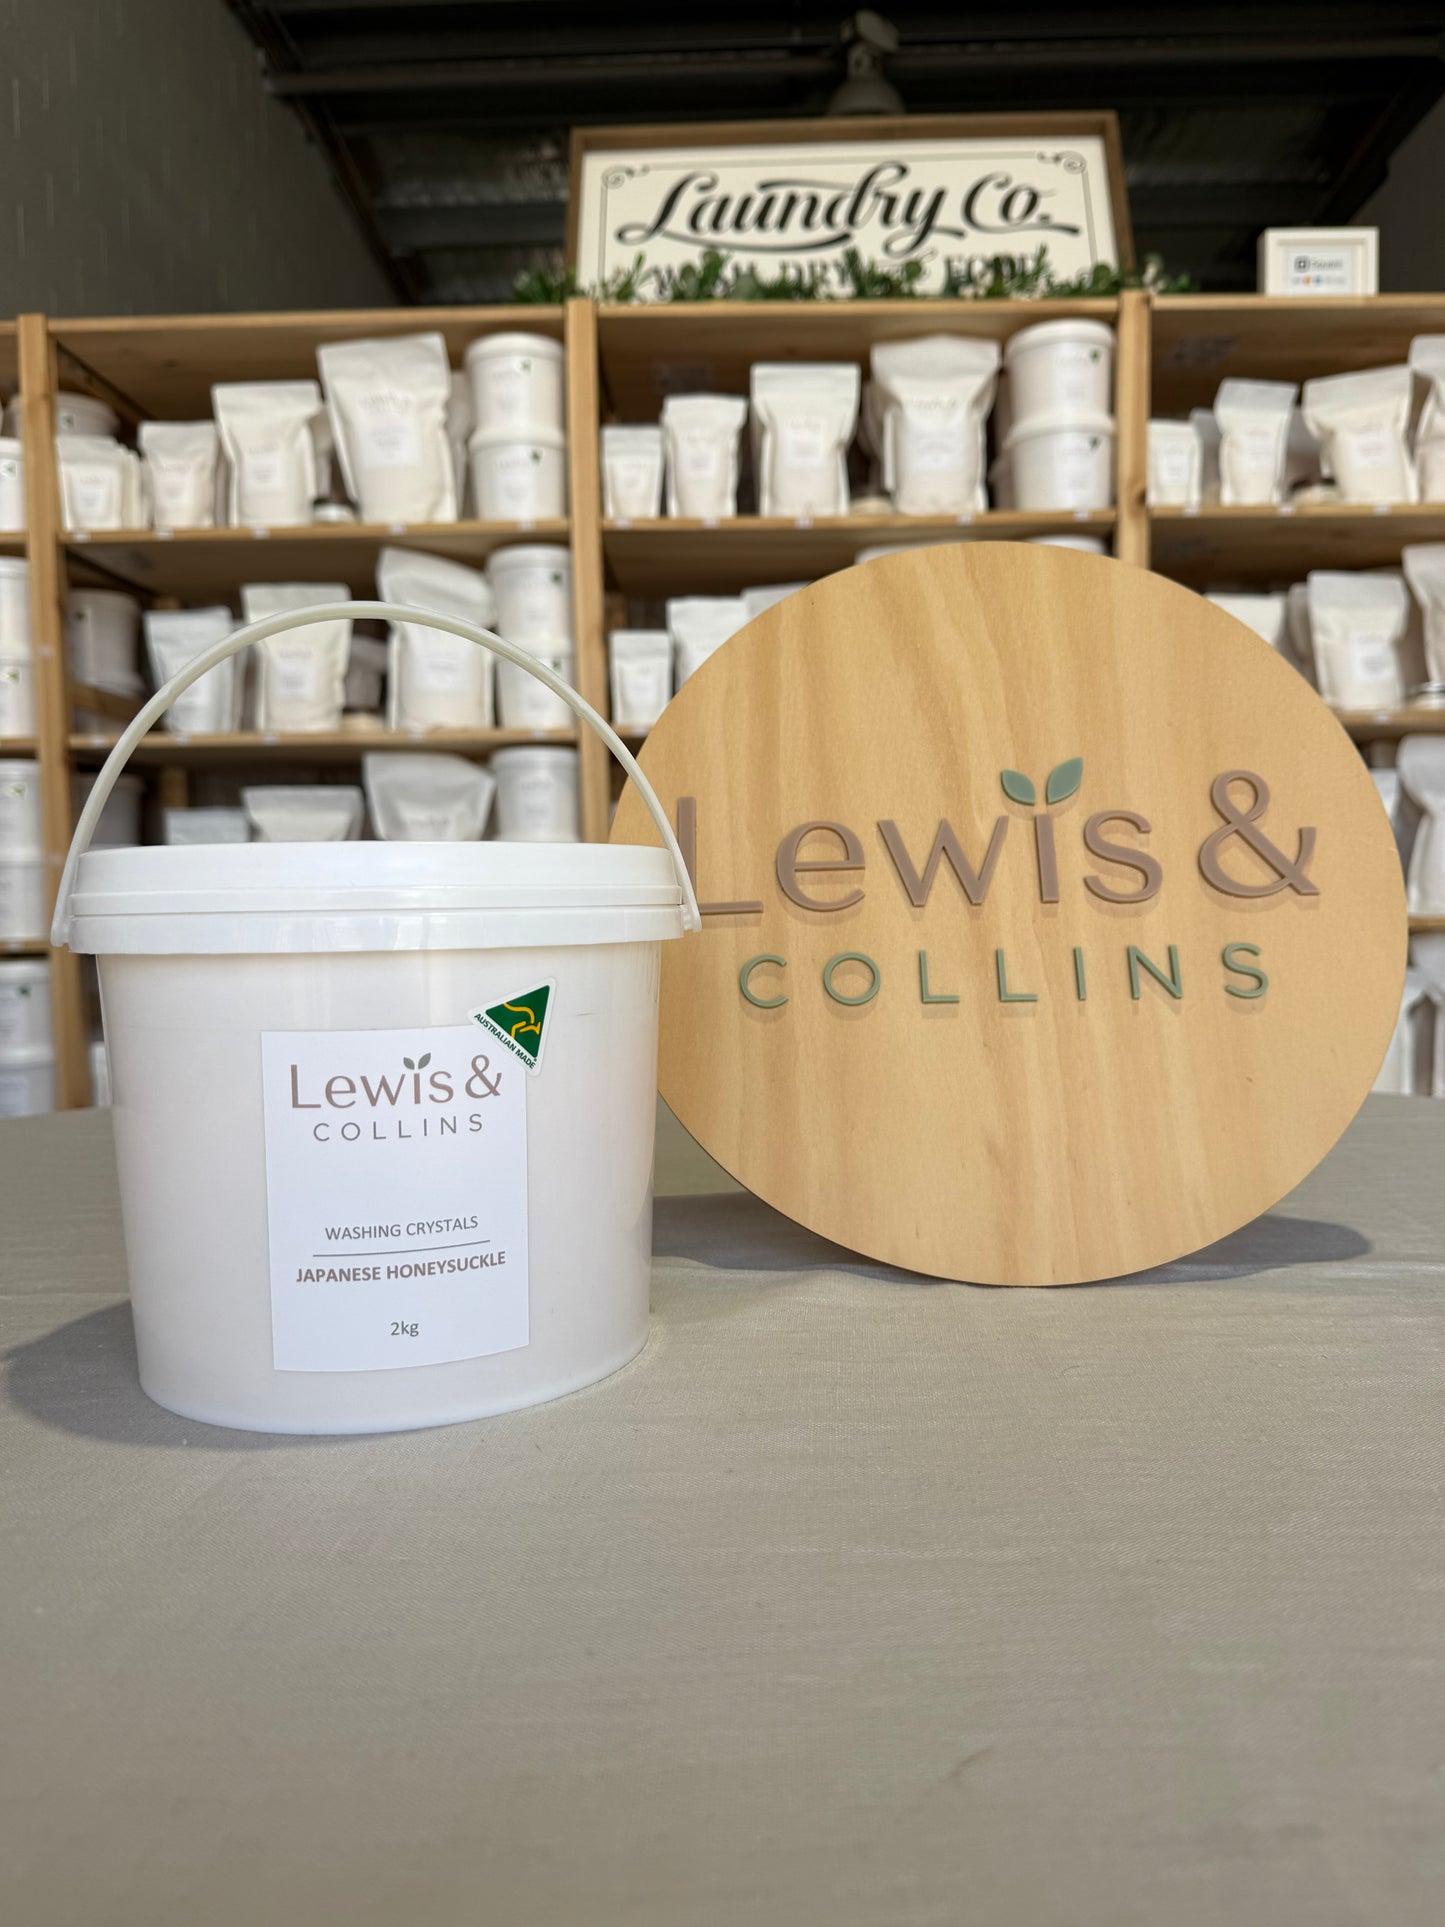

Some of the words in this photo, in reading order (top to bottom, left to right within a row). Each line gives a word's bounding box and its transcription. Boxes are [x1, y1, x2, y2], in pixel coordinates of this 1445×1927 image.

[615, 160, 966, 258] Laundry
[961, 171, 1081, 236] Co.
[676, 757, 1163, 914] Lewis
[1197, 769, 1321, 899] &
[739, 942, 1270, 1009] COLLINS
[474, 1013, 517, 1052] AUSTRALIAN
[515, 1049, 537, 1070] MADE
[290, 1053, 455, 1109] Lewis
[464, 1054, 503, 1099] &
[313, 1113, 483, 1142] COLLINS
[325, 1224, 401, 1241] WASHING
[406, 1215, 479, 1236] CRYSTALS
[296, 1266, 381, 1283] JAPANESE
[386, 1250, 506, 1279] HONEYSUCKLE
[390, 1321, 420, 1338] 2kg
